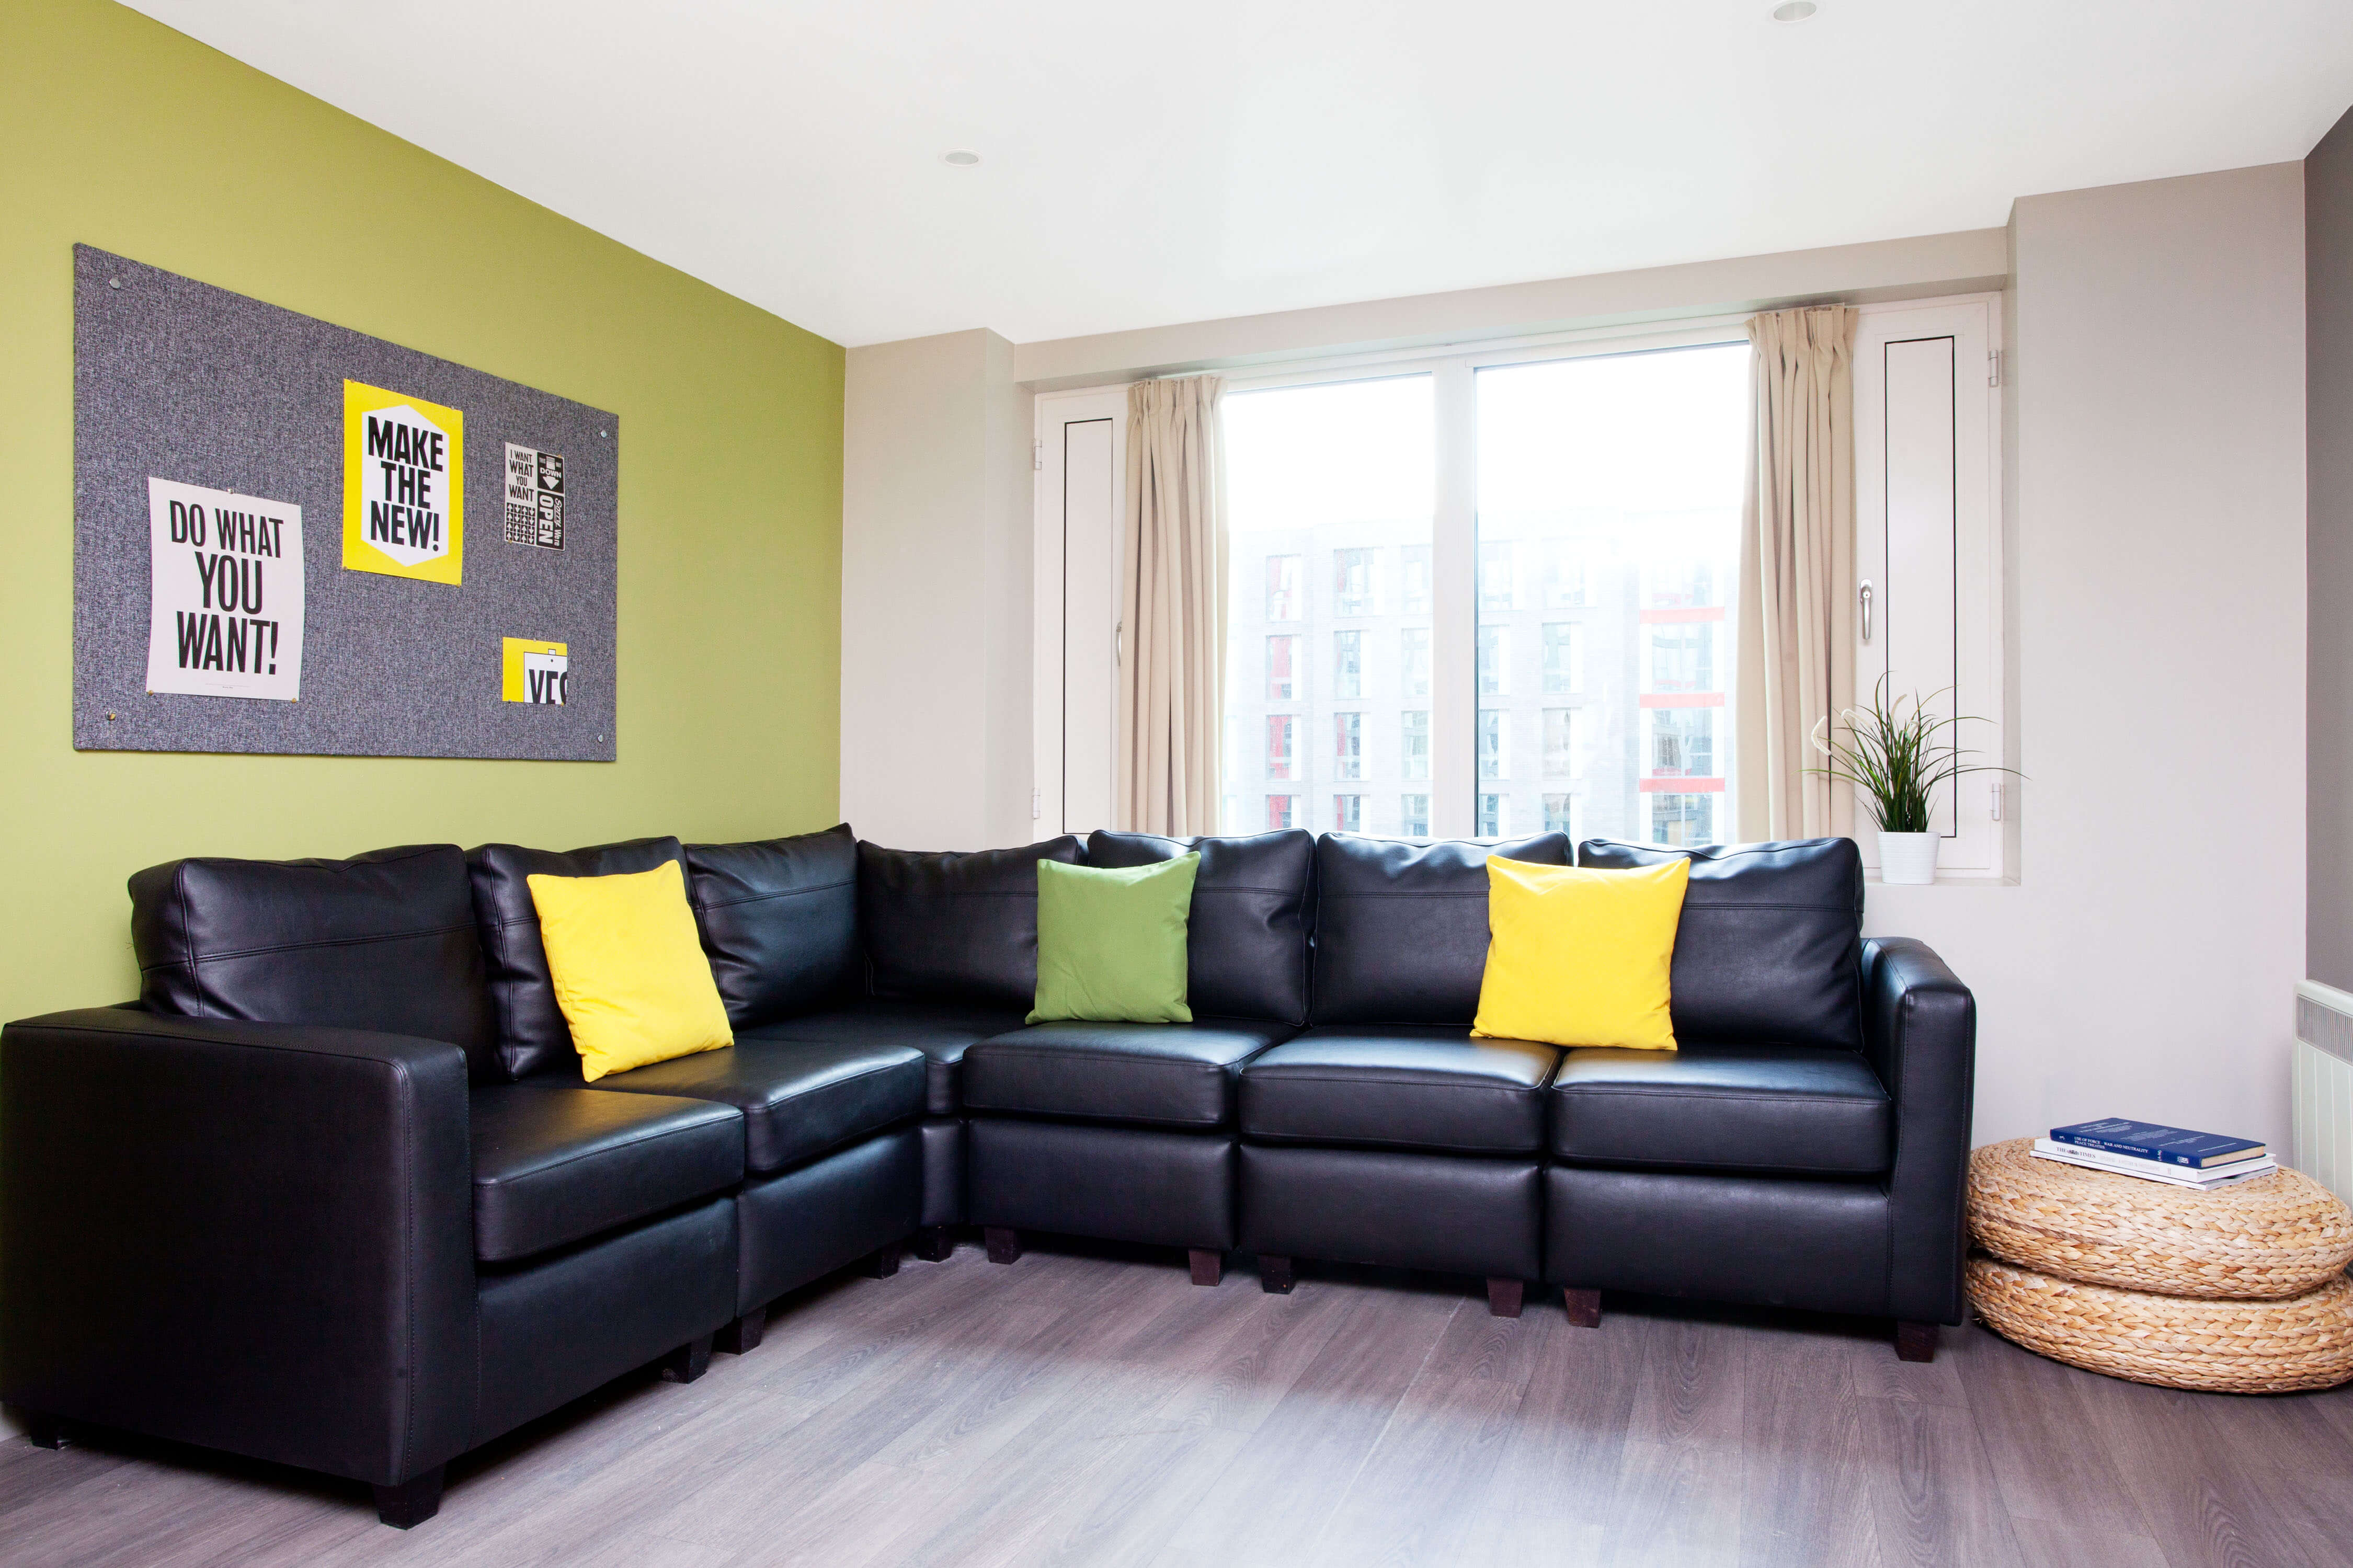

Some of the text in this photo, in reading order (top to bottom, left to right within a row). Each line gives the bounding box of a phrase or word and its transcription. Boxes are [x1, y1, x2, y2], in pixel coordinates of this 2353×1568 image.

[368, 416, 443, 472] MAKE
[510, 449, 532, 463] I WANT
[381, 461, 430, 509] THE
[509, 459, 534, 477] WHAT
[516, 475, 528, 487] YOU
[540, 467, 562, 478] DOWN
[508, 484, 534, 502] WANT
[169, 500, 283, 558] DO WHAT
[371, 500, 440, 552] NEW!
[539, 495, 554, 544] OPEN
[554, 498, 562, 528] Sorry
[195, 551, 262, 615] YOU
[177, 611, 278, 675] WANT!
[2123, 1144, 2149, 1153] NEUTRALITY
